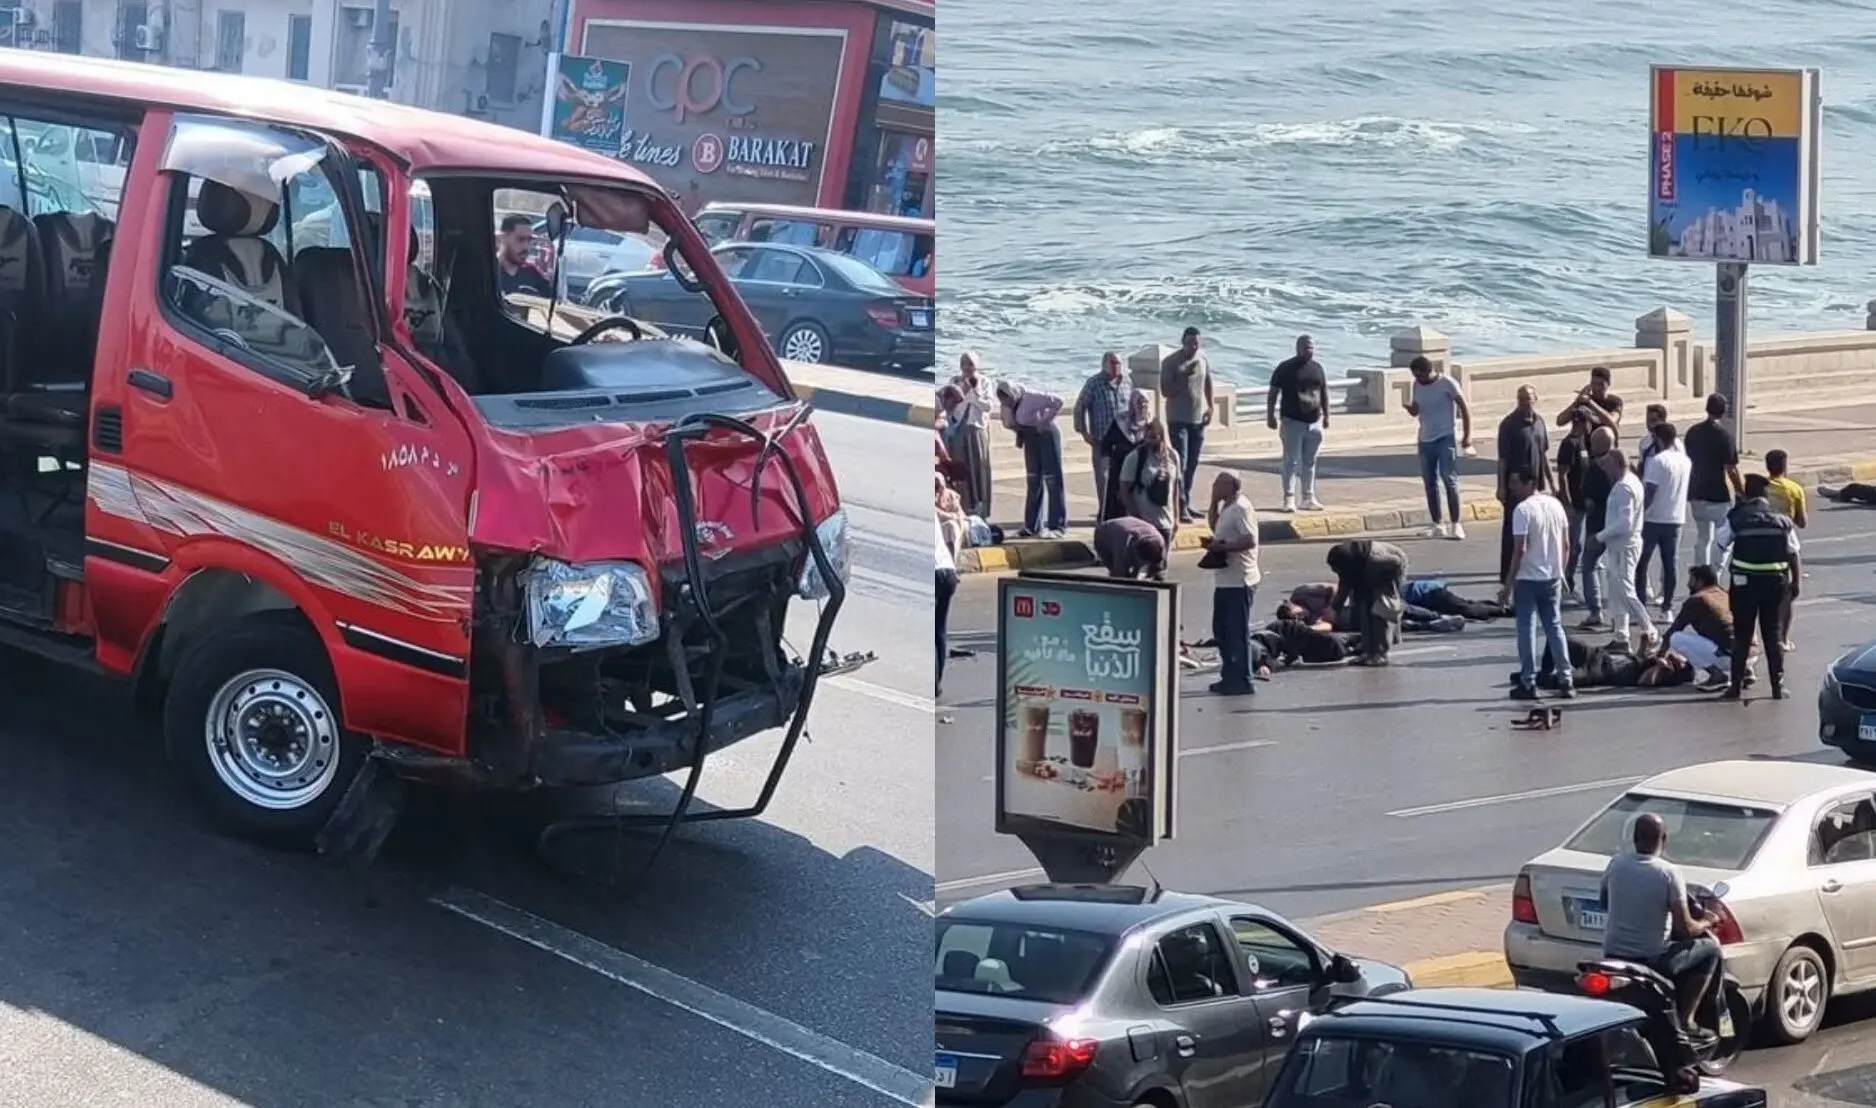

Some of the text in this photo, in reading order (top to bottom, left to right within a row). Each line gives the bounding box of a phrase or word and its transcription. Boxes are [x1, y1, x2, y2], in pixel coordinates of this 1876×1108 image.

[728, 135, 813, 168] BARAKAT
[1661, 131, 1673, 196] PHASE 2
[328, 520, 470, 562] EL KASRAWY
